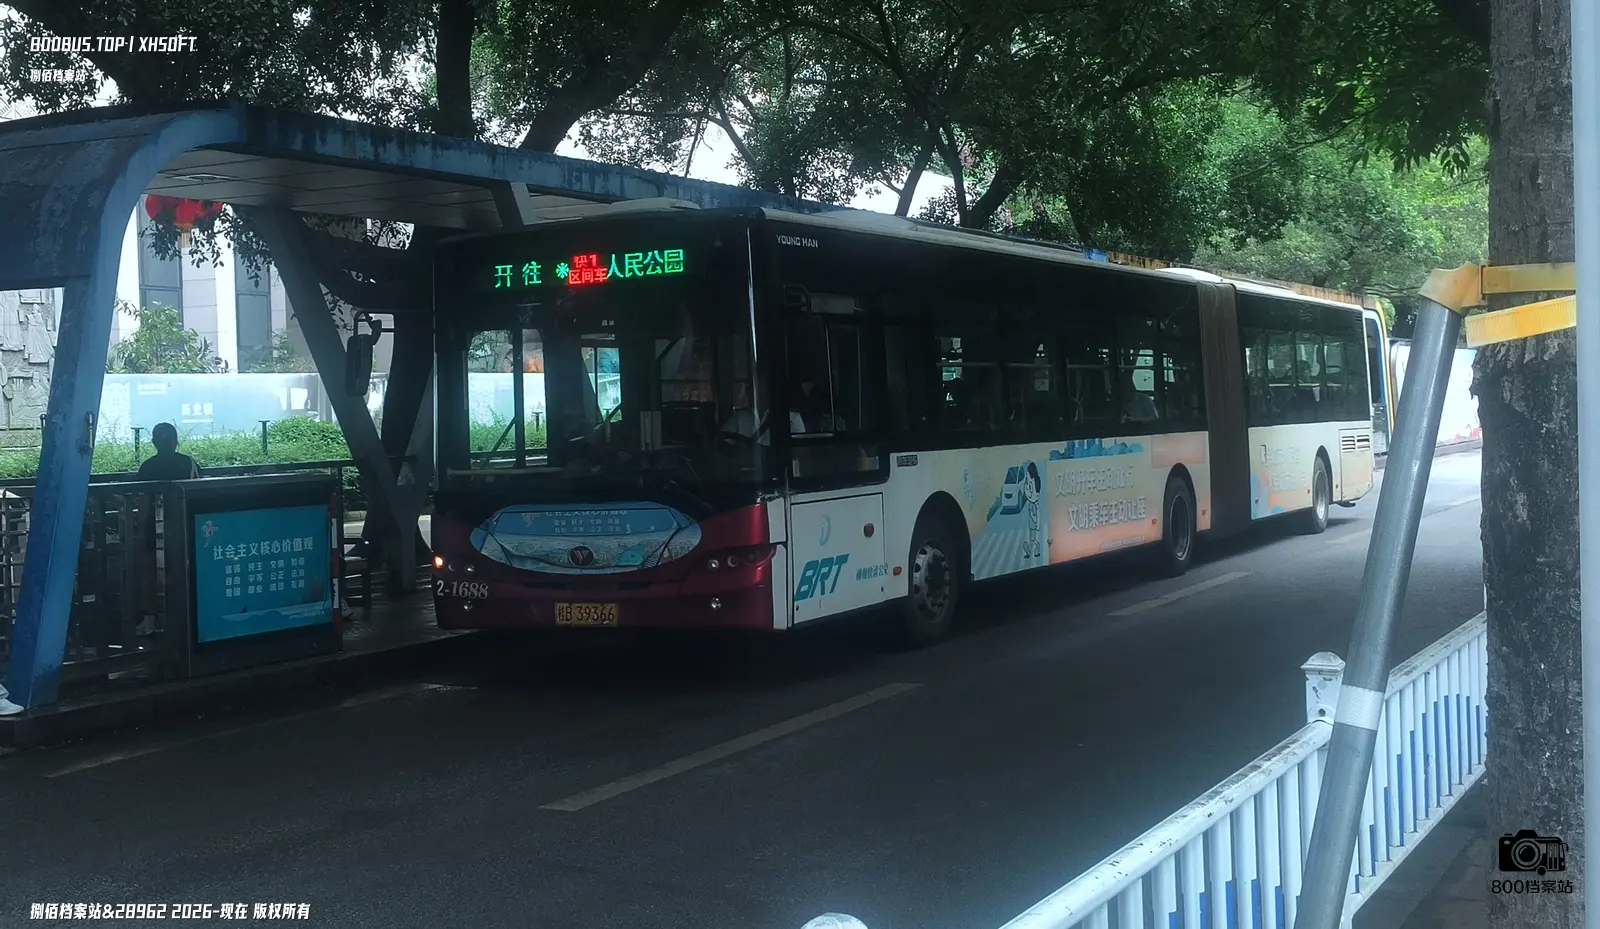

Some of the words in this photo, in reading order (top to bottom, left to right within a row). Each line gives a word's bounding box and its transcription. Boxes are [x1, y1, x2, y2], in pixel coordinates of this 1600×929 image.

[776, 234, 801, 246] YOUNG
[802, 238, 818, 248] MAN
[573, 254, 598, 268] 快1
[607, 249, 684, 278] 人民公园
[568, 267, 609, 285] 区间车
[1068, 497, 1146, 532] 文明乘车主动让座
[213, 537, 314, 560] 社会主义核心价值观
[248, 562, 263, 572] 民主
[225, 576, 241, 586] 自由
[270, 571, 284, 580] 公正
[794, 554, 850, 602] BRT
[436, 580, 489, 600] 2-1688
